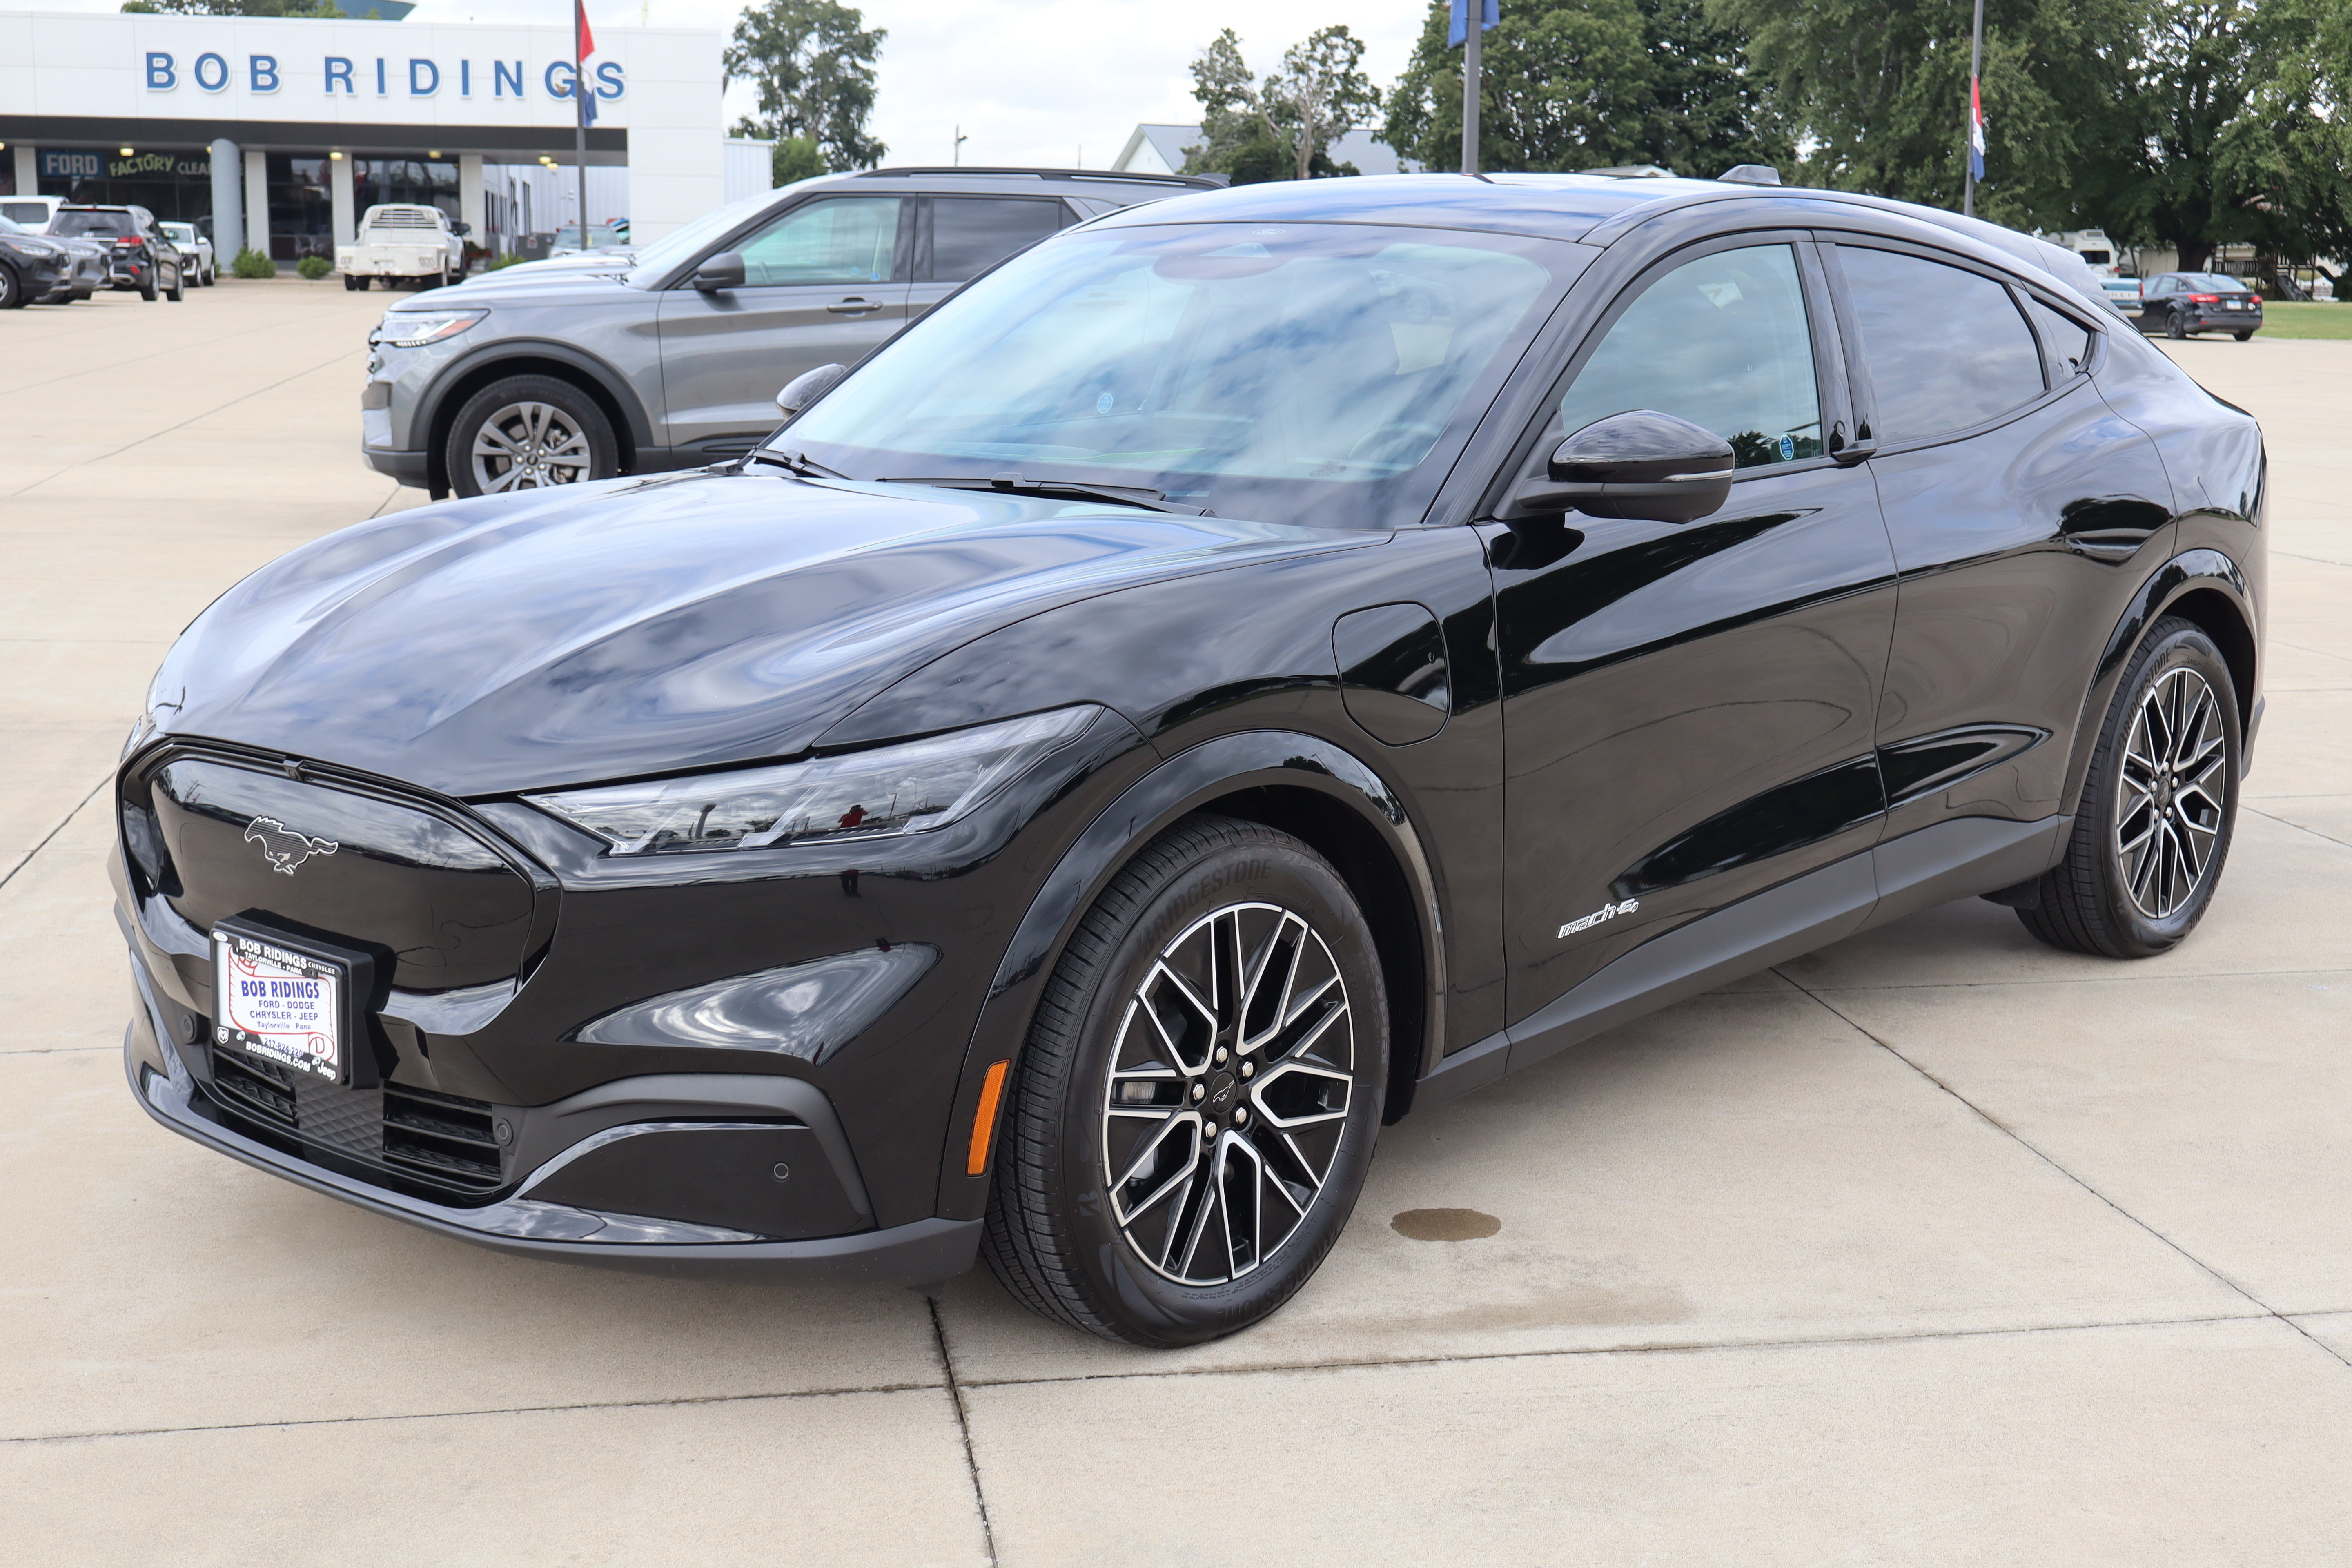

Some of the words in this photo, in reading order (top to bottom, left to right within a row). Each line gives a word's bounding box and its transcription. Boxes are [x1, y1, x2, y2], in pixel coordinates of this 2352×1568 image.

[145, 51, 282, 94] BOB
[324, 55, 627, 101] RIDINGS
[46, 154, 98, 175] FORD
[109, 154, 175, 177] FACTORY
[177, 161, 212, 176] CLEA
[1136, 858, 1273, 960] BRIDGESTONE
[239, 938, 261, 955] BOB
[264, 946, 307, 969] RIDINGS
[244, 951, 282, 969] TAYLORVILLE
[286, 964, 303, 976] PANA
[308, 962, 335, 975] CHRYSLER
[241, 980, 267, 997] BOB
[271, 980, 320, 999] RIDINGS
[250, 1010, 292, 1020] CHRYSLER
[298, 1012, 318, 1020] JEEP
[258, 1000, 280, 1009] FORD
[287, 1001, 315, 1009] DODGE
[257, 1021, 290, 1030] Taylorville
[246, 1041, 311, 1072] BOBRIDINGS.COM
[317, 1062, 336, 1081] Jeep
